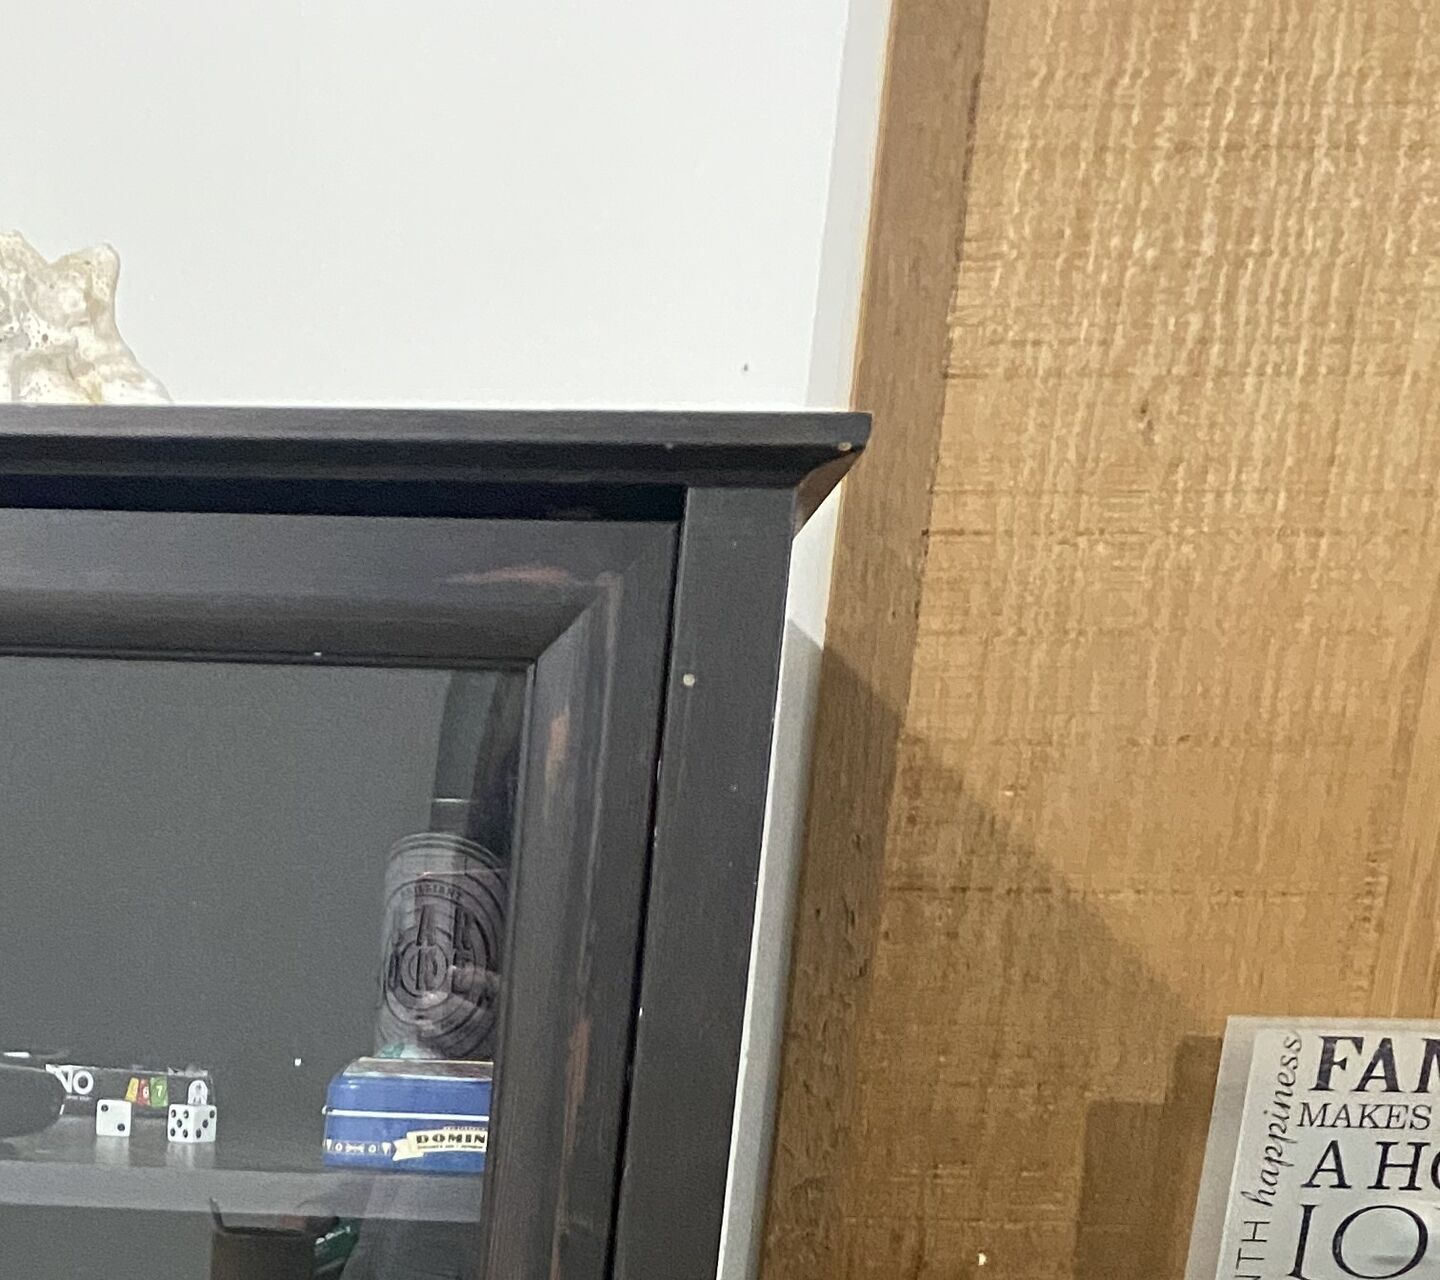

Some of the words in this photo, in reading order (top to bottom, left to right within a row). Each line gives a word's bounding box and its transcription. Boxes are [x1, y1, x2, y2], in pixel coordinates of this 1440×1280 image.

[1241, 1031, 1302, 1206] happiness
[1296, 1101, 1433, 1130] MAKES
[416, 1133, 486, 1144] DOMIN
[1300, 1139, 1352, 1189] A
